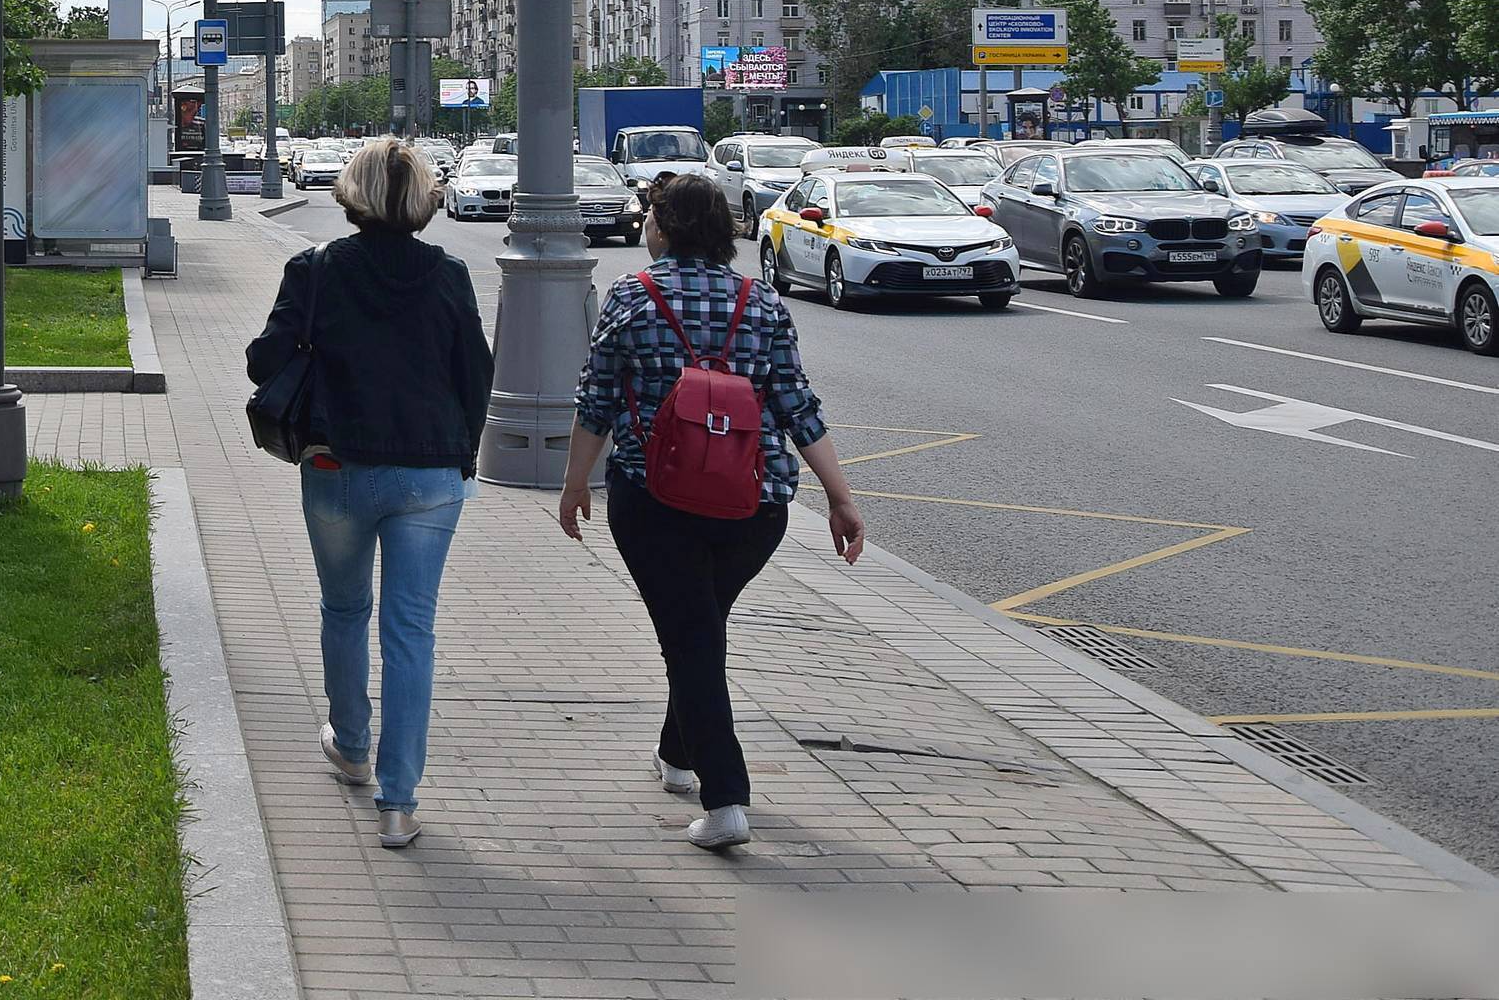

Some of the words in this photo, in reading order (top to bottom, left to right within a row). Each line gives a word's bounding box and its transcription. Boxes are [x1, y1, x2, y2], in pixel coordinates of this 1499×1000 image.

[742, 54, 771, 62] ЗДЕСЬ
[729, 63, 784, 71] СБЫВАЮТСЯ
[749, 72, 780, 80] МЕЧТЫ
[827, 150, 867, 159] Яндекс
[870, 150, 886, 159] Go
